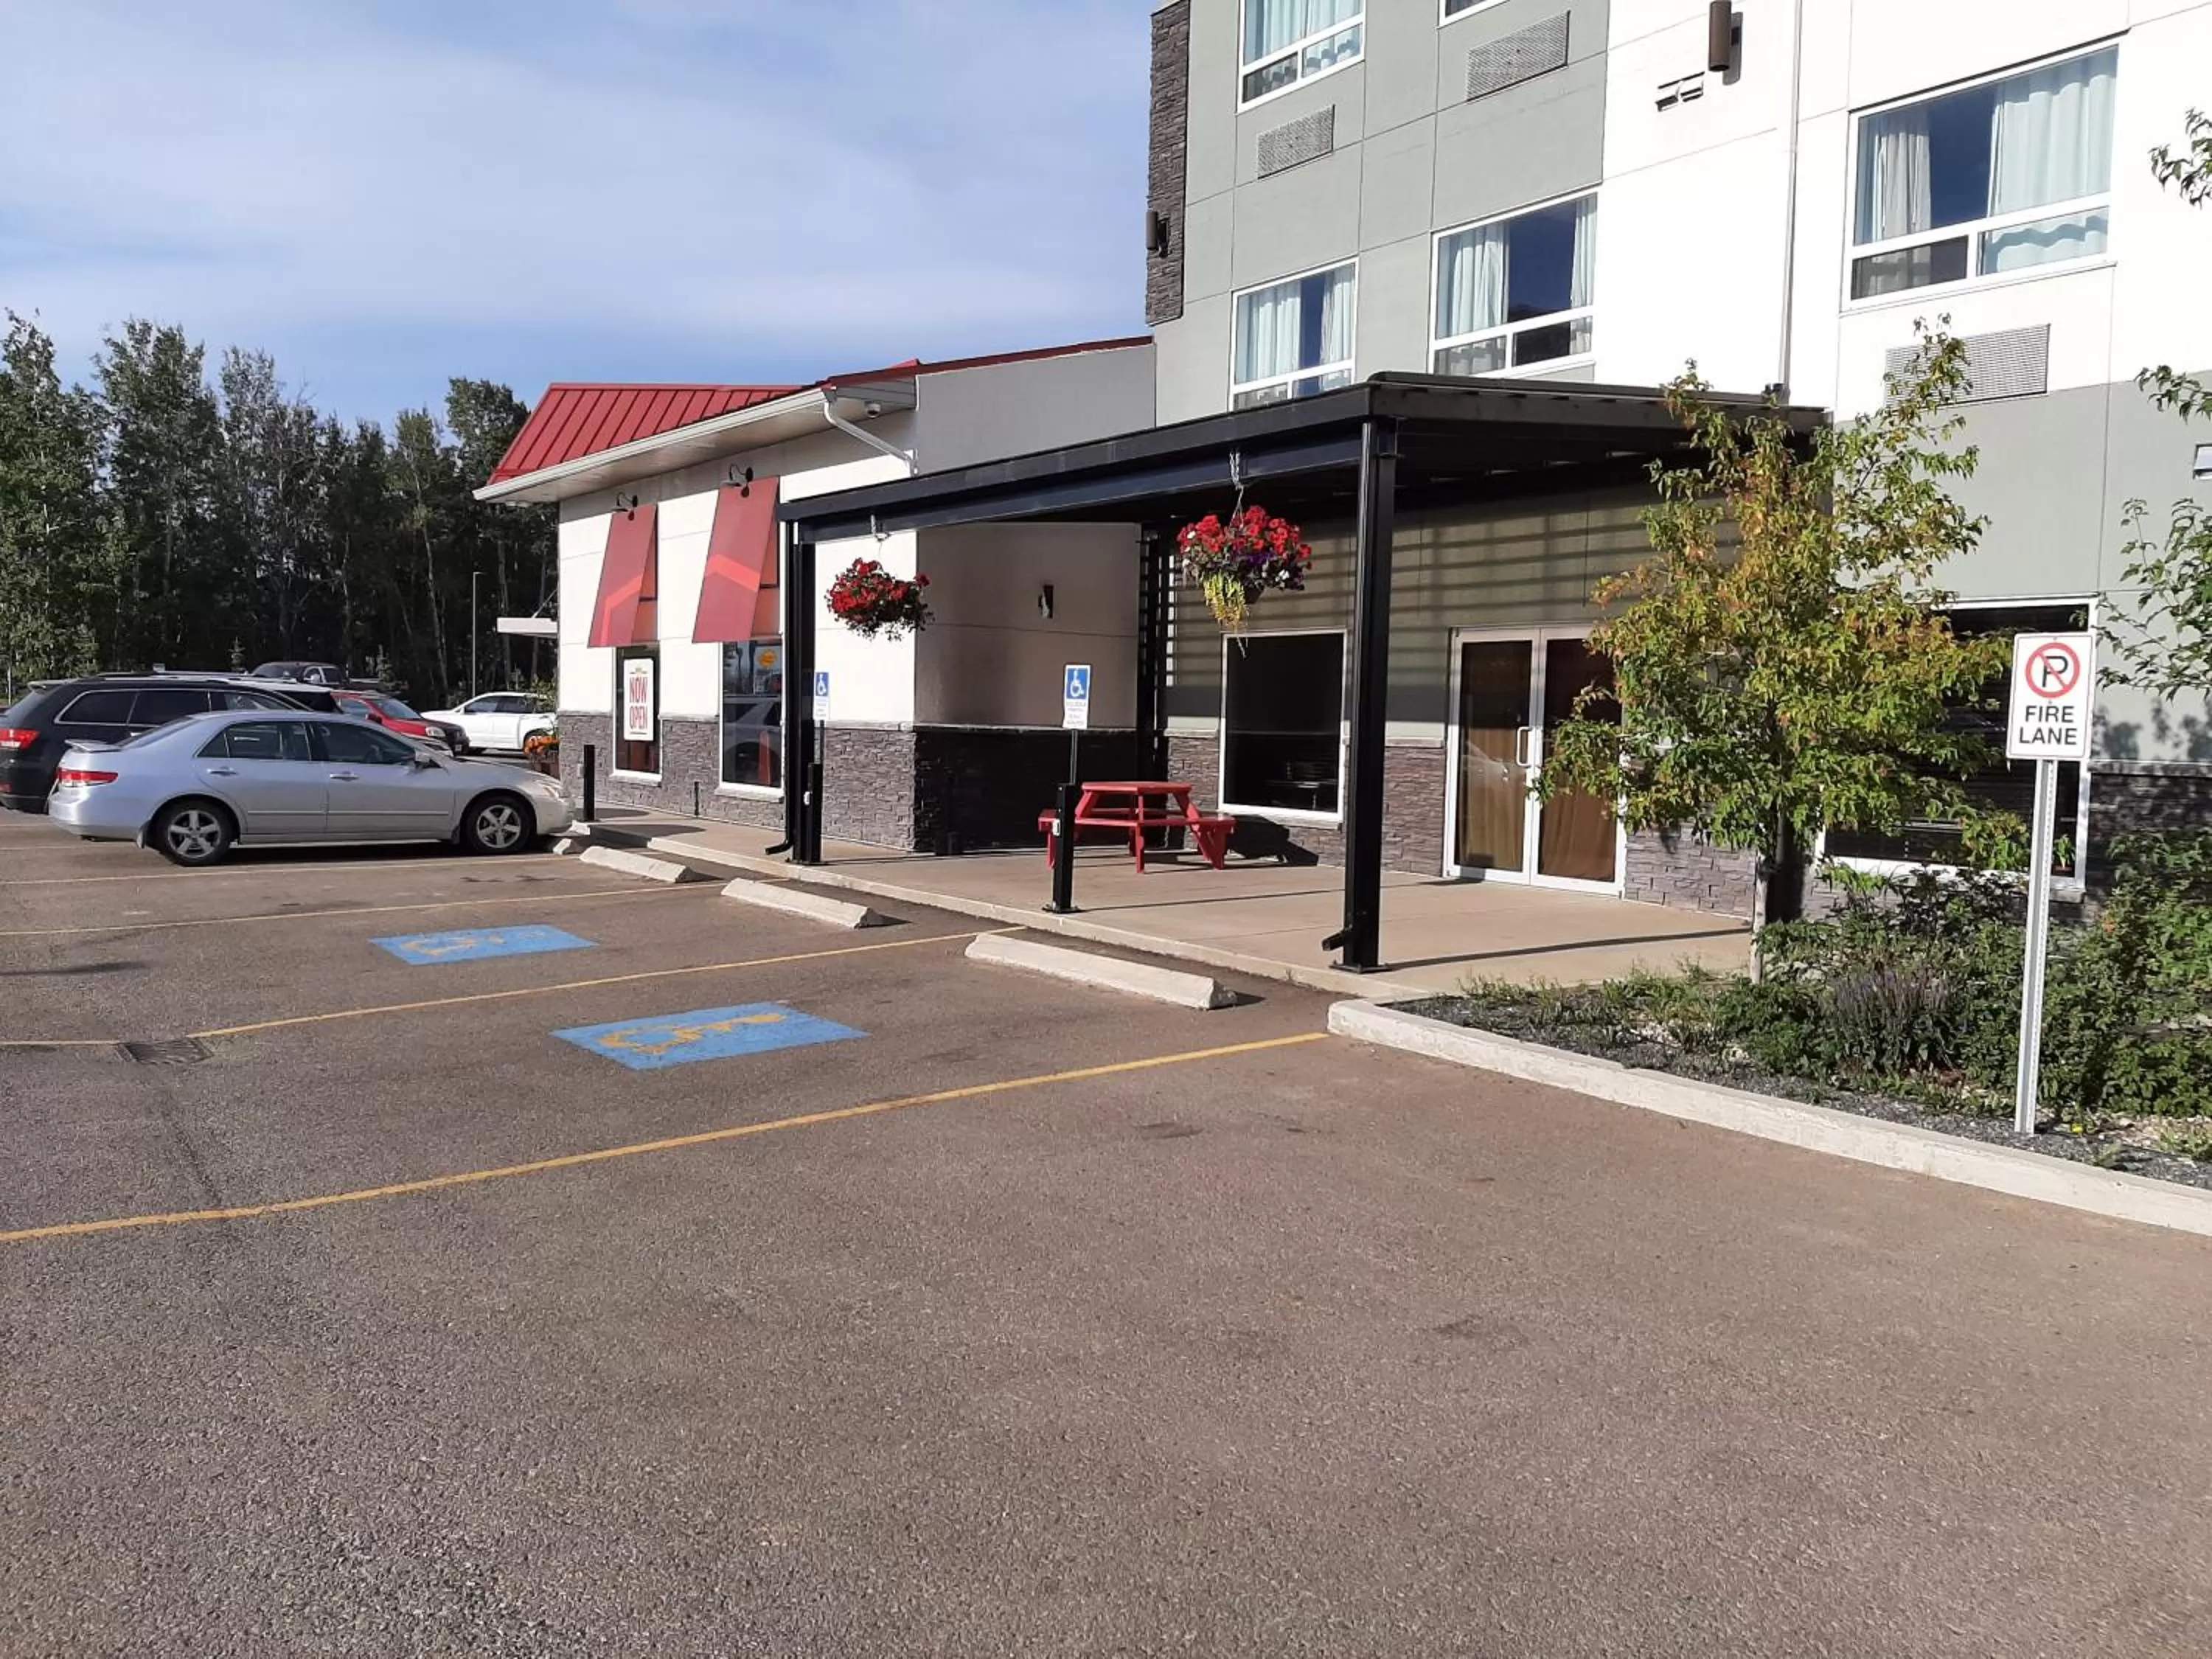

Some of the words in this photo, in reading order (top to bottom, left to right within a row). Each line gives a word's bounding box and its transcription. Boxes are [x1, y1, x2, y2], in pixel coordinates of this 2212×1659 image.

[629, 676, 648, 703] NOW
[629, 705, 648, 729] OPEN
[2025, 705, 2075, 723] FIRE
[2019, 726, 2078, 745] LANE
